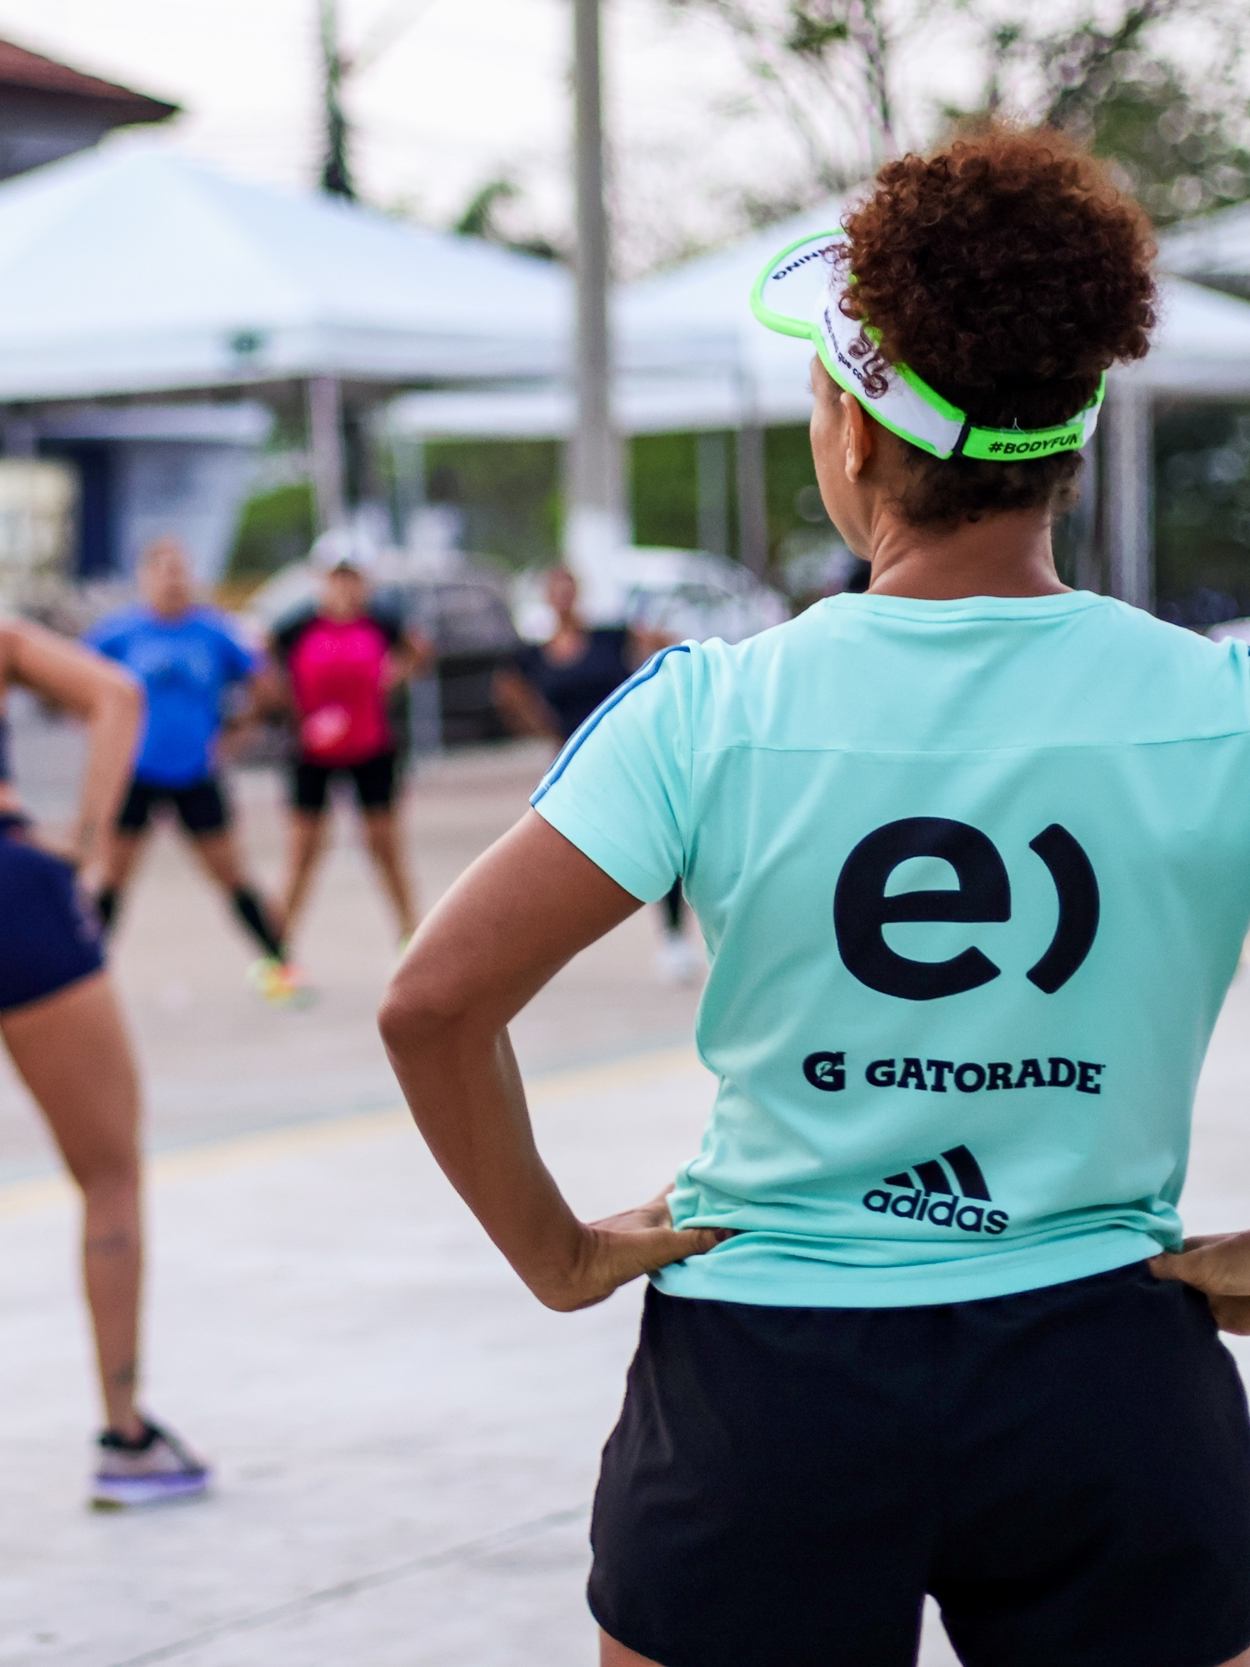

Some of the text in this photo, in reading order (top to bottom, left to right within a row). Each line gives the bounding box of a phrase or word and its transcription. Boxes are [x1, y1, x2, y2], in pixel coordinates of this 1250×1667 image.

[772, 249, 824, 280] NING
[865, 1057, 1104, 1094] GATORADE
[862, 1188, 1010, 1235] adidas
